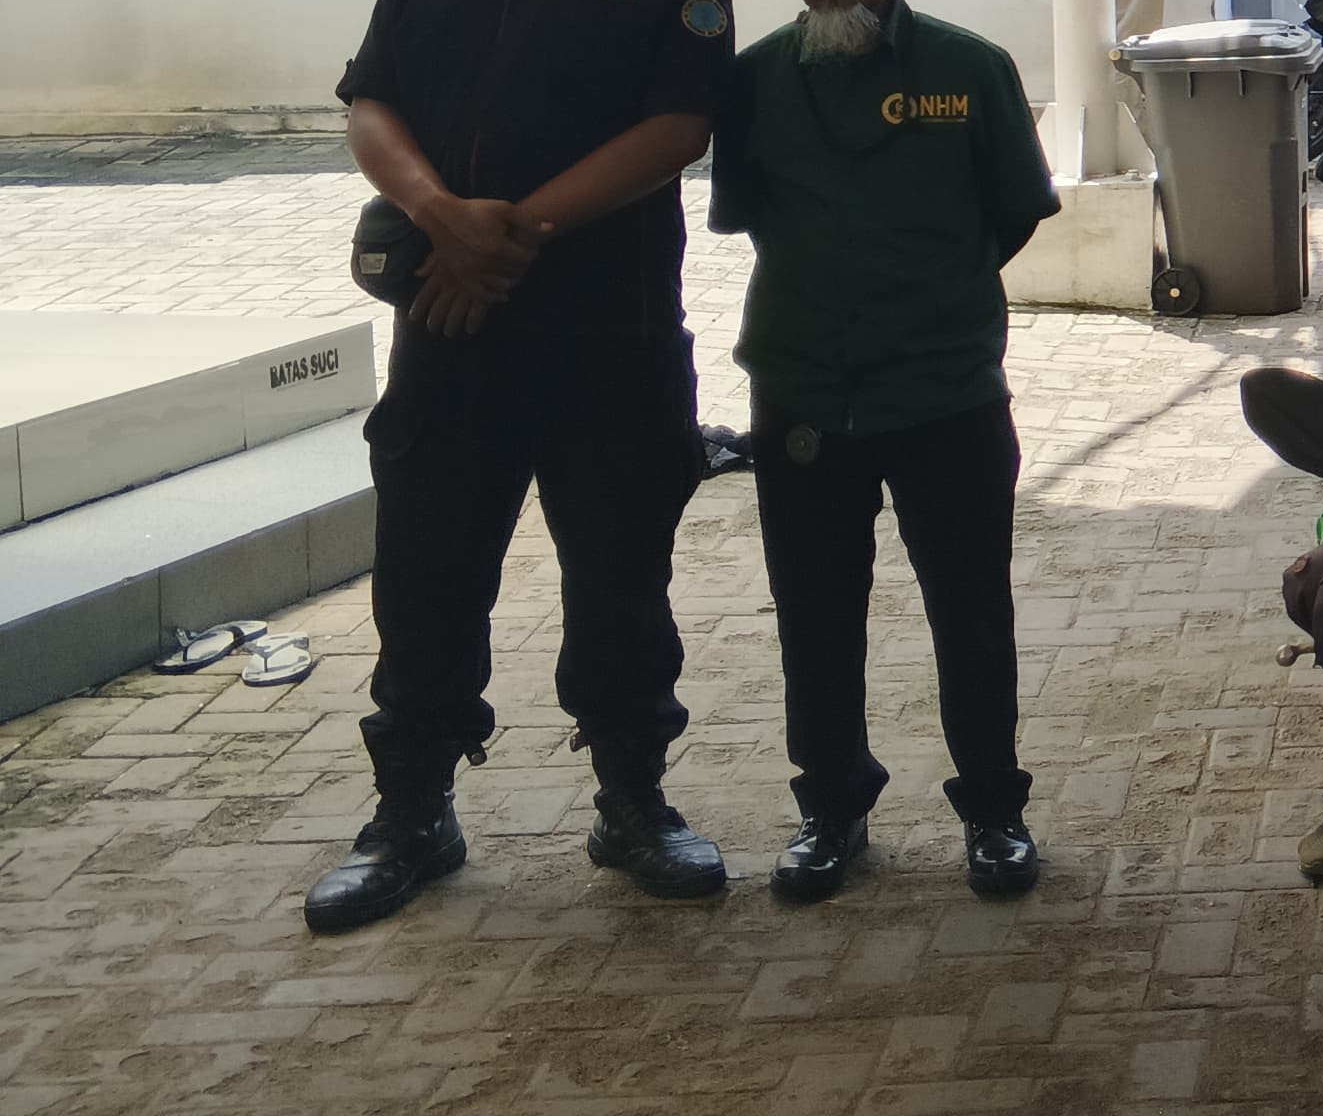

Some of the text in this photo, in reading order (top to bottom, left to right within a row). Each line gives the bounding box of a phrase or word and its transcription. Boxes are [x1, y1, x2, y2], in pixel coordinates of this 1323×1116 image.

[919, 94, 969, 118] NHM
[269, 347, 340, 389] BATAS SUCI
